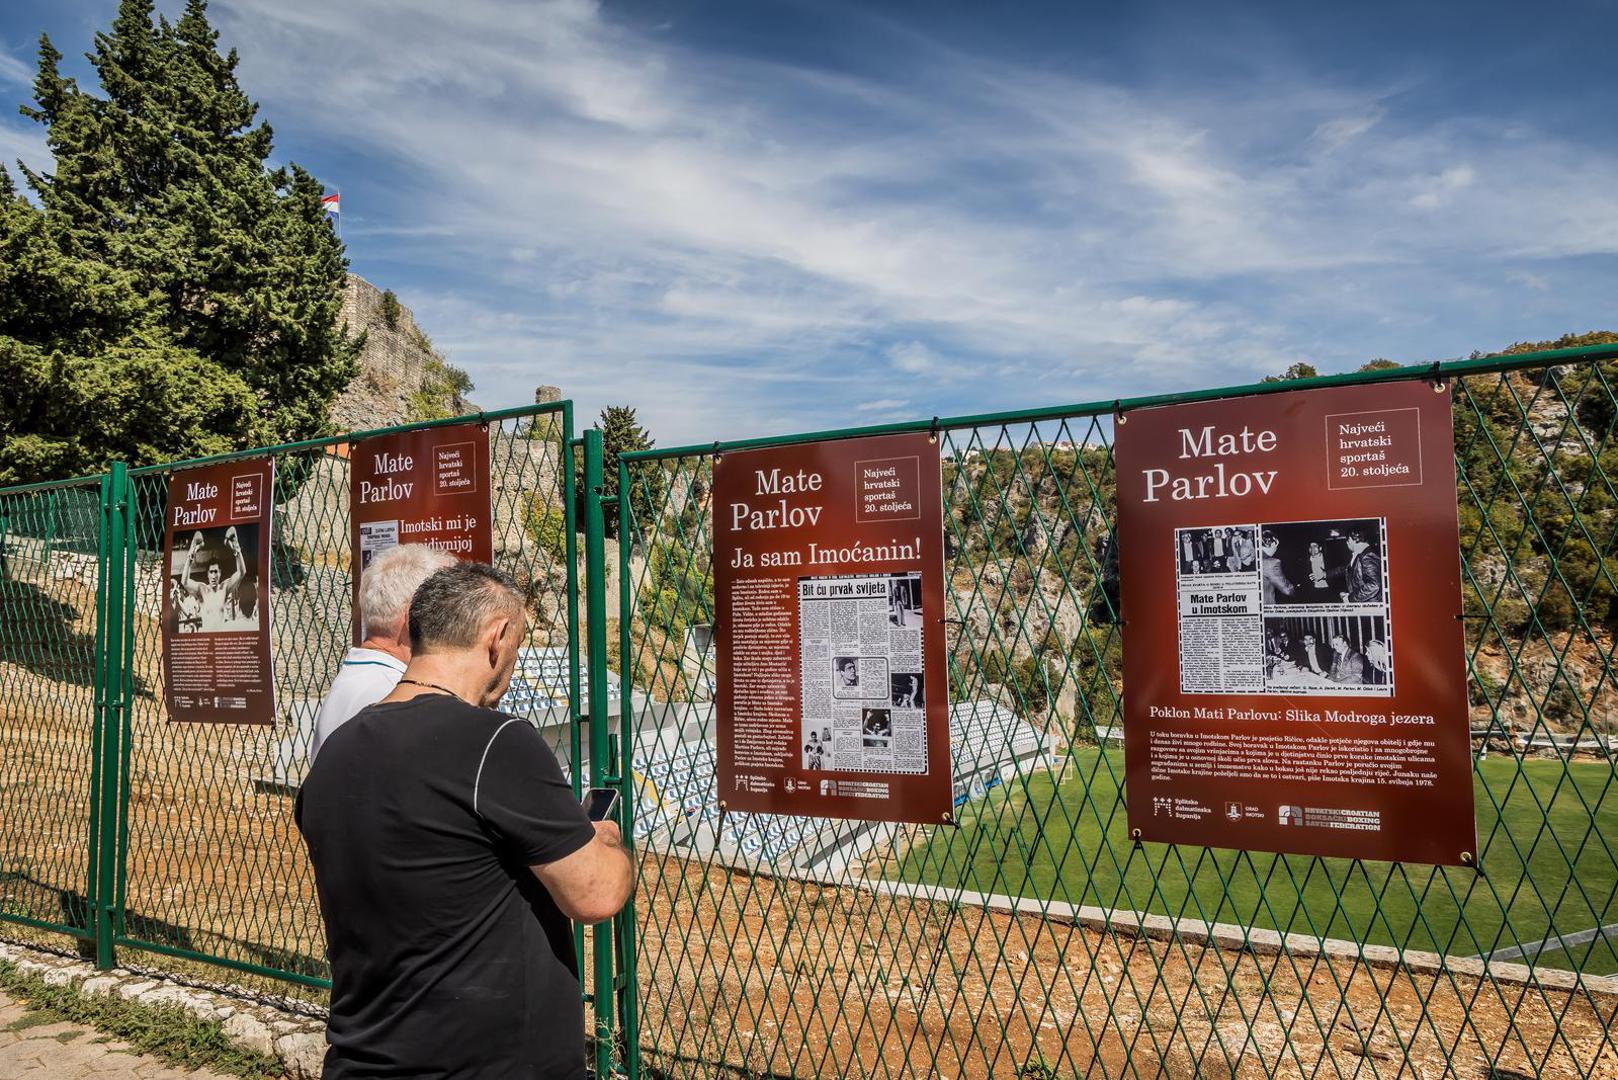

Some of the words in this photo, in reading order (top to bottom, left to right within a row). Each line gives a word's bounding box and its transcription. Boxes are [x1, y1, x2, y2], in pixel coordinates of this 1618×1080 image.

[1338, 421, 1386, 436] Najveći
[1178, 426, 1277, 459] Mate
[1339, 436, 1392, 449] hrvatski
[374, 452, 413, 475] Mate
[1340, 450, 1386, 464] sportaš
[439, 461, 462, 470] hrvatski
[864, 467, 896, 479] Najveći
[1340, 467, 1360, 478] 20.
[1362, 462, 1410, 478] stoljeća
[440, 470, 460, 479] sportaš
[754, 468, 822, 496] Mate
[864, 479, 900, 490] hrvatski
[1142, 463, 1278, 502] Parlov
[186, 482, 218, 502] Mate
[360, 478, 414, 504] Parlov
[864, 489, 896, 502] sportaš
[864, 504, 878, 513] 20.
[880, 500, 912, 513] stoljeća
[173, 504, 217, 526] Parlov
[730, 500, 823, 531] Parlov
[400, 516, 442, 534] Imotski
[446, 514, 462, 530] mi
[464, 514, 476, 532] je
[730, 547, 754, 568] Ja
[760, 549, 802, 567] sam
[808, 536, 922, 565] Imoćanin!
[802, 584, 814, 596] Bit
[816, 584, 826, 595] ću
[830, 582, 854, 596] prvak
[856, 582, 886, 596] svijeta
[1190, 594, 1214, 604] Mate
[1216, 592, 1247, 603] Parlov
[1192, 606, 1198, 614] u
[1200, 604, 1247, 614] Imotskom
[1150, 706, 1190, 718] Poklon
[1194, 707, 1224, 720] Mati
[1227, 708, 1281, 720] Parlovu:
[1286, 708, 1320, 722] Slika
[1325, 710, 1386, 726] Modroga
[1390, 712, 1435, 726] jezera
